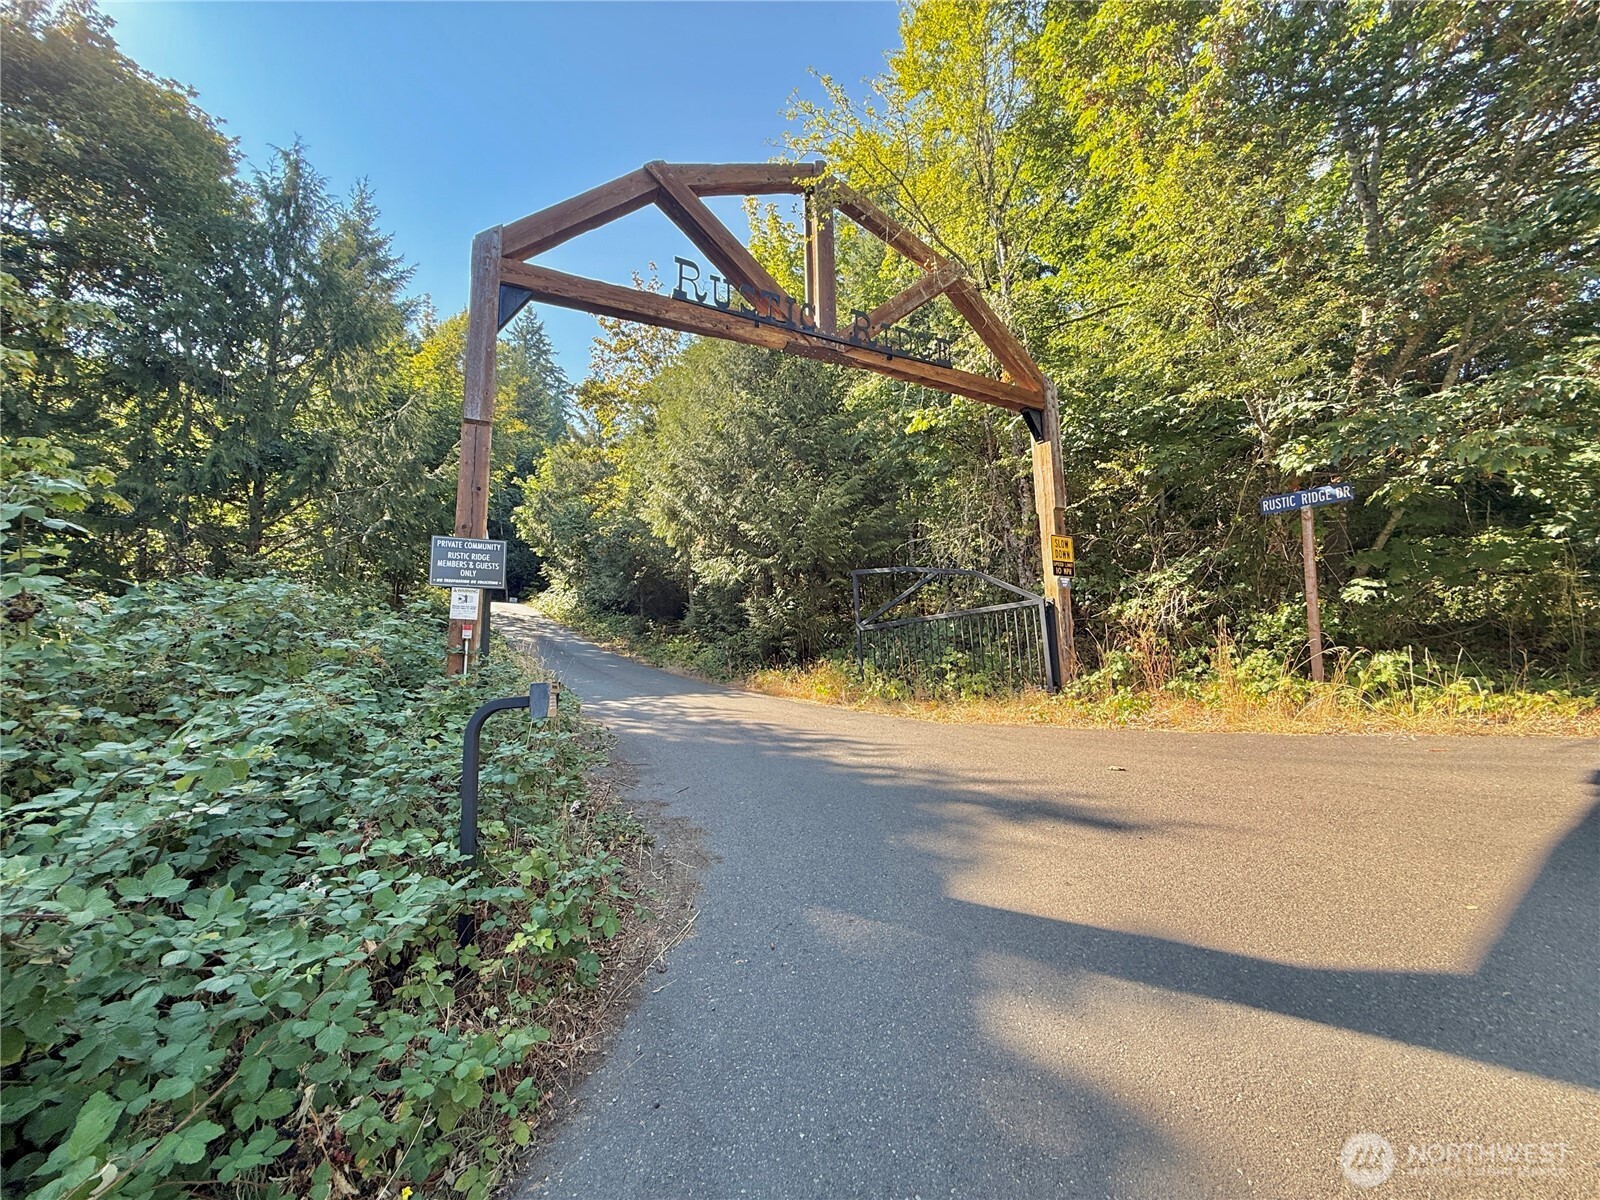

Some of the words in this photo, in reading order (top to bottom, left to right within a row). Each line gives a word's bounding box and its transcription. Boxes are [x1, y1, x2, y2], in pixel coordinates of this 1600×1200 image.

[672, 256, 817, 331] RUSTIC
[849, 309, 952, 367] RIDGE
[1262, 495, 1296, 512] RUSTIC
[1301, 488, 1332, 505] RIDGE
[1335, 485, 1351, 499] DR
[437, 540, 462, 549] PRIVATE
[464, 542, 501, 551] COMMUNITY
[1054, 539, 1069, 549] SLOW
[447, 551, 470, 560] RUSTIC
[471, 553, 491, 561] RIDGE
[1055, 549, 1071, 559] DOWN
[437, 559, 467, 568] MEMBERS
[468, 561, 474, 569] &
[460, 569, 477, 577] ONLY
[1055, 567, 1062, 575] 10
